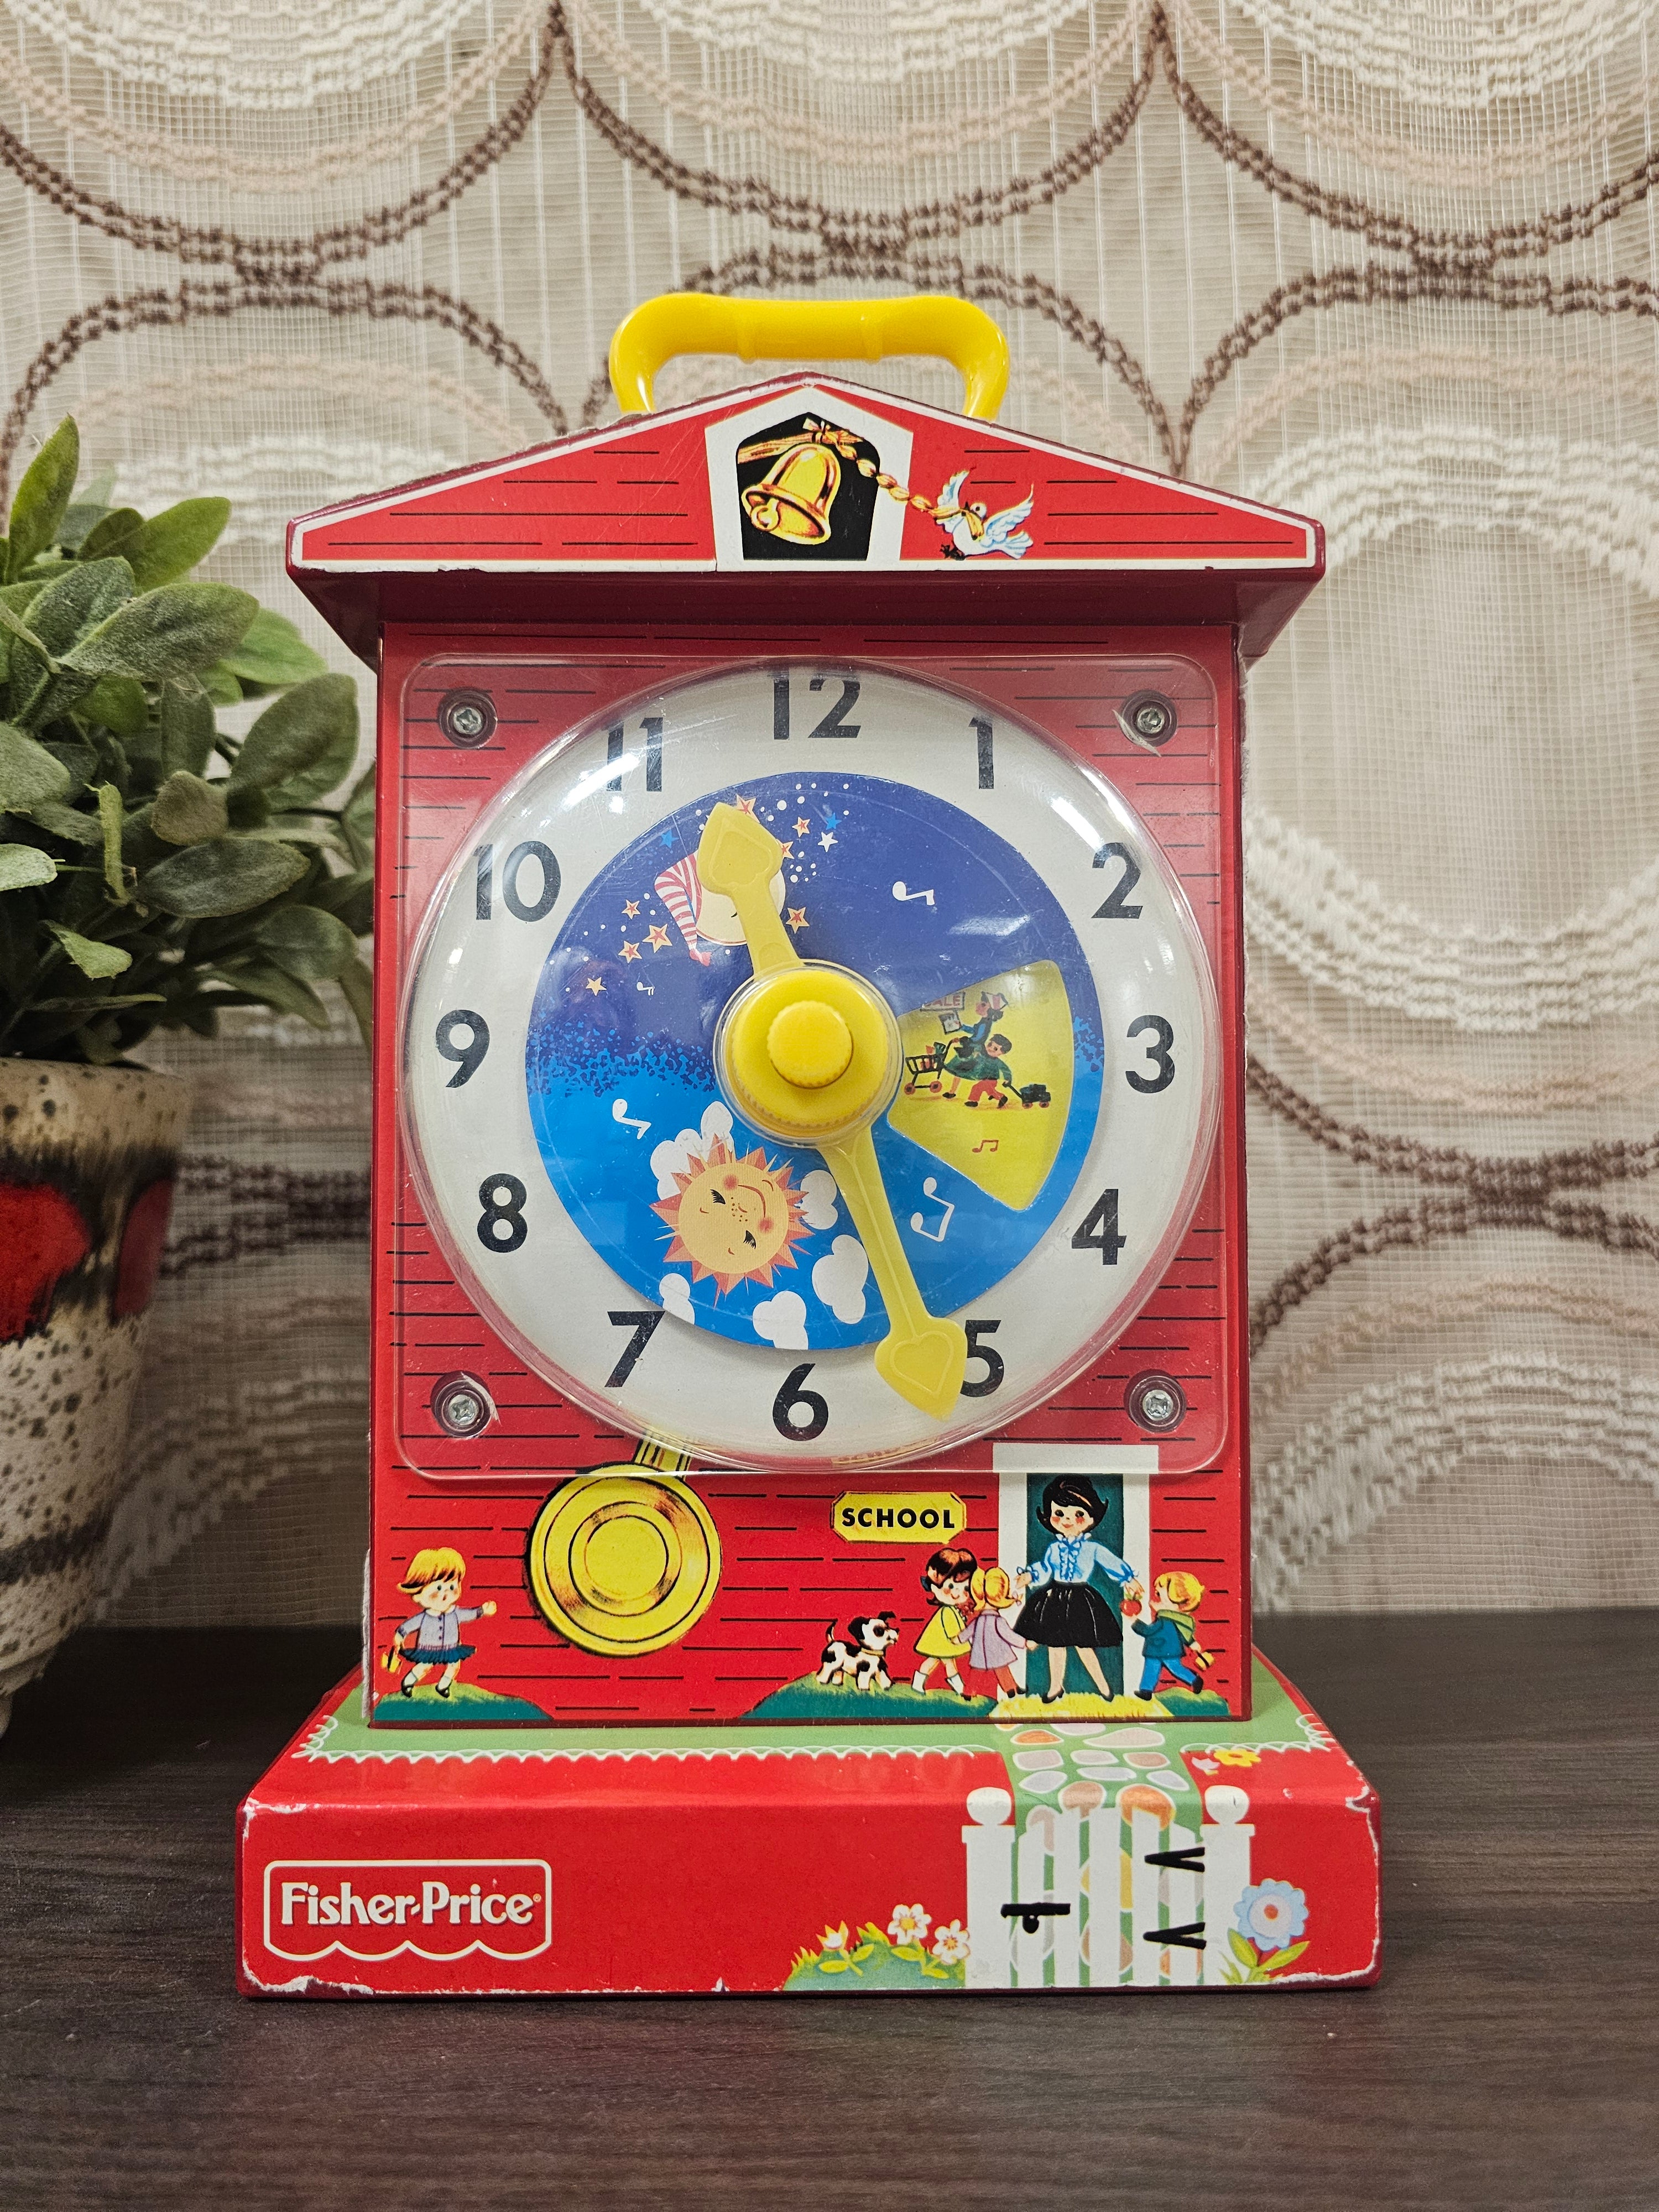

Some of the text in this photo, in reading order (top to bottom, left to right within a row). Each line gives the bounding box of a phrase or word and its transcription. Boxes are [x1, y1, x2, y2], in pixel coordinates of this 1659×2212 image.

[767, 671, 861, 740] 12
[601, 717, 664, 791] 11
[968, 717, 994, 789] 1
[473, 841, 561, 922] 10
[1091, 842, 1143, 919] 2
[924, 995, 961, 1008] ALE
[436, 1009, 490, 1088] 9
[1125, 1015, 1175, 1093] 3
[477, 1173, 528, 1253] 8
[1072, 1188, 1126, 1265] 4
[604, 1311, 665, 1387] 7
[960, 1319, 1004, 1397] 5
[773, 1363, 828, 1441] 6
[842, 1507, 954, 1528] SCHOOL
